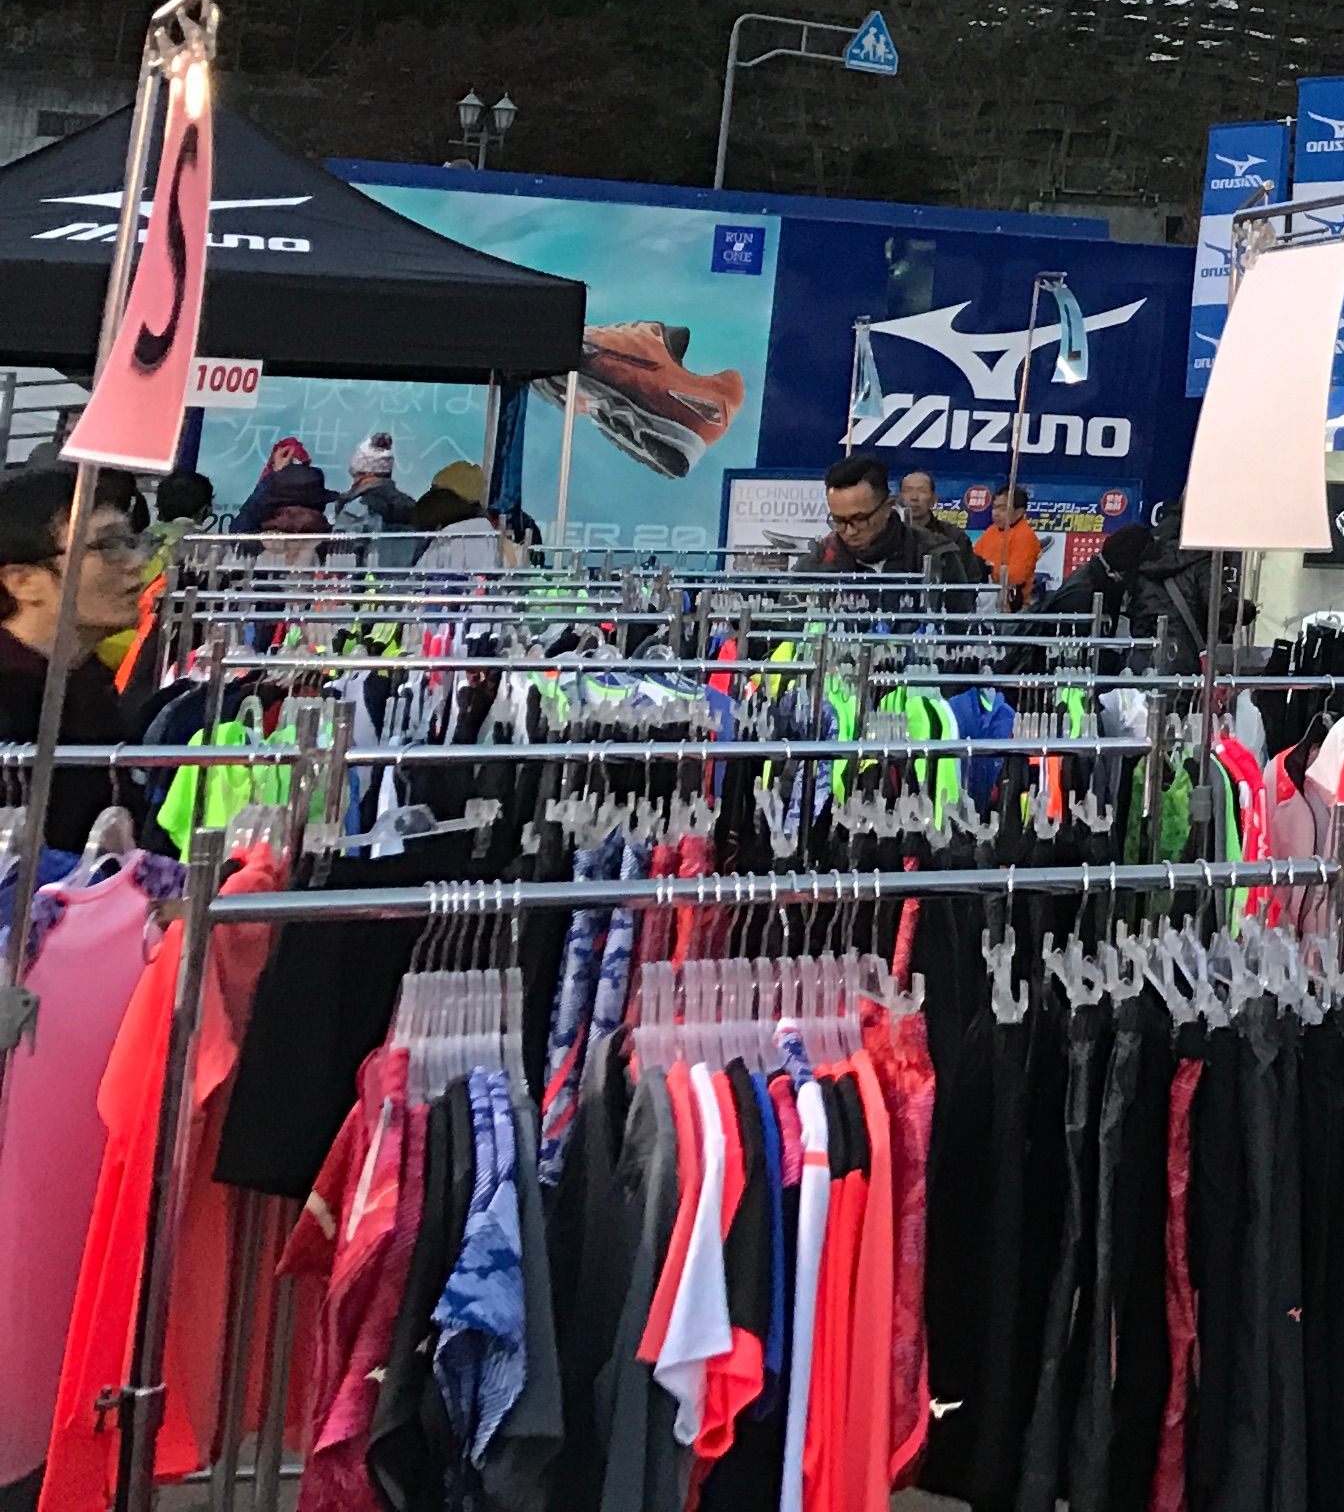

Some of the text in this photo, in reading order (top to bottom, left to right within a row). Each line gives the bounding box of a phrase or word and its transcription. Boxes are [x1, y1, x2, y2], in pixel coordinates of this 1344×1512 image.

[30, 222, 311, 253] MIUNO
[196, 364, 259, 394] 1000
[735, 500, 830, 517] CLOUDWA
